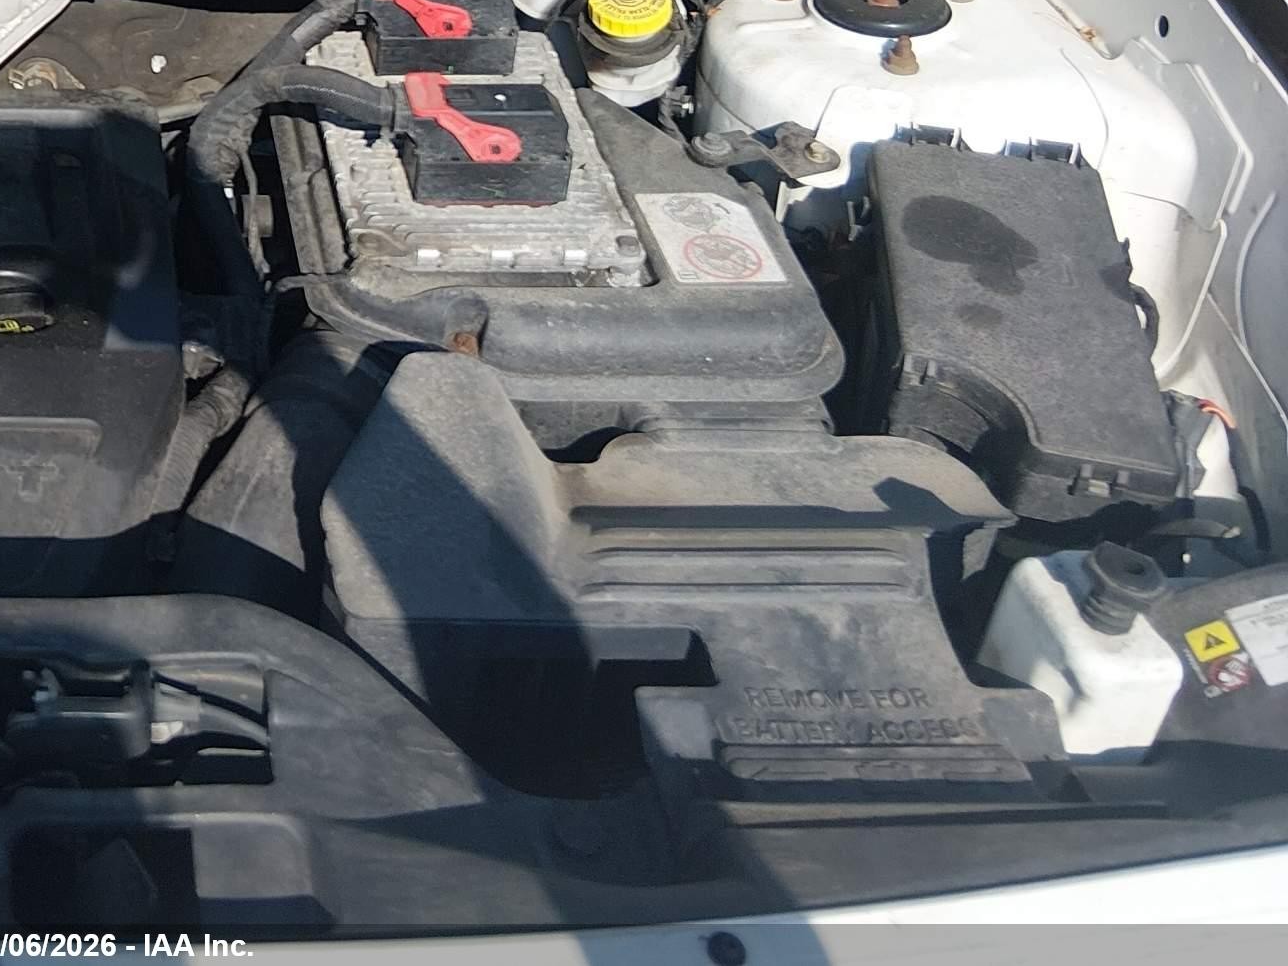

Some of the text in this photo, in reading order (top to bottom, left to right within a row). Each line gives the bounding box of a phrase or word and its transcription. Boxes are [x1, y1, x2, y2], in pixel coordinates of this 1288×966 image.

[744, 686, 930, 710] REMOVE FOR
[733, 717, 979, 743] BATTERY ACCESS
